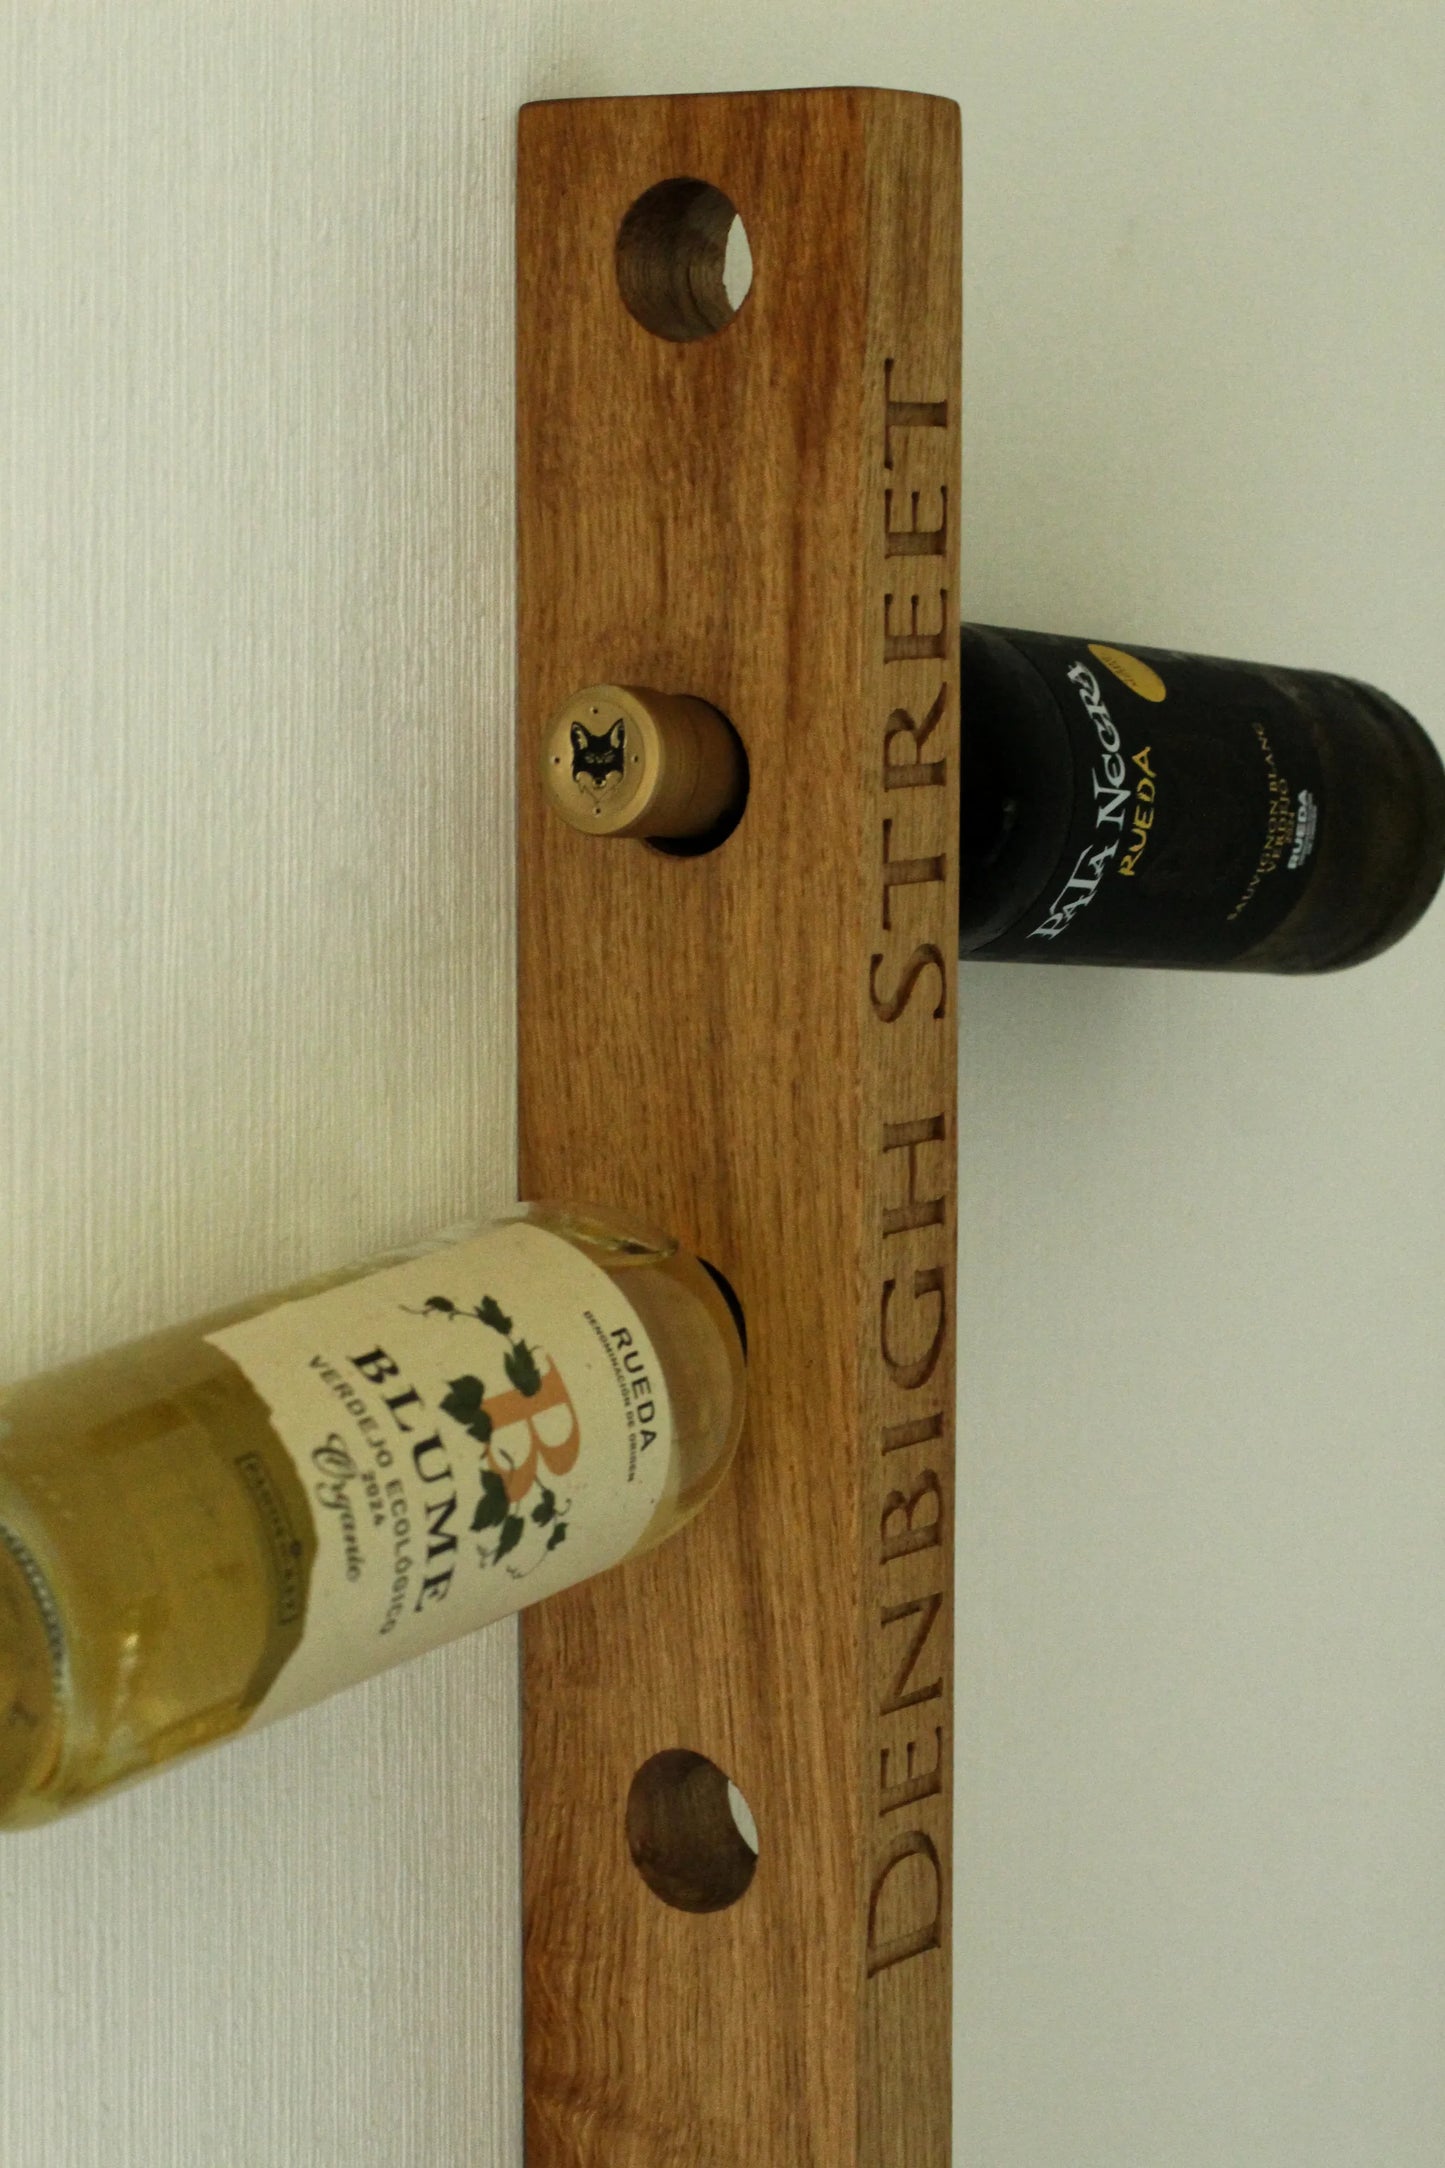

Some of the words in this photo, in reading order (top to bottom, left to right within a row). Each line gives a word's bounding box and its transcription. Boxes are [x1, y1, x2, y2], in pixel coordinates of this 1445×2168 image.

[870, 357, 947, 1024] STREET
[1066, 661, 1132, 830] NEGRA
[1117, 746, 1157, 876] RUEDA
[1251, 721, 1278, 792] BLANC
[1026, 838, 1119, 940] PATA
[1226, 800, 1279, 921] SAUVIGNON
[1287, 789, 1308, 869] RUEDA
[480, 1354, 581, 1503] B
[611, 1327, 657, 1452] RUEDA
[625, 1411, 635, 1428] DE
[308, 1354, 394, 1469] VERDEJO
[379, 1480, 411, 1635] ECOLÓGICO
[311, 1434, 366, 1583] Organic
[346, 1345, 458, 1614] BLUME
[362, 1471, 386, 1528] 2024
[866, 1117, 947, 1979] DENBIGH
